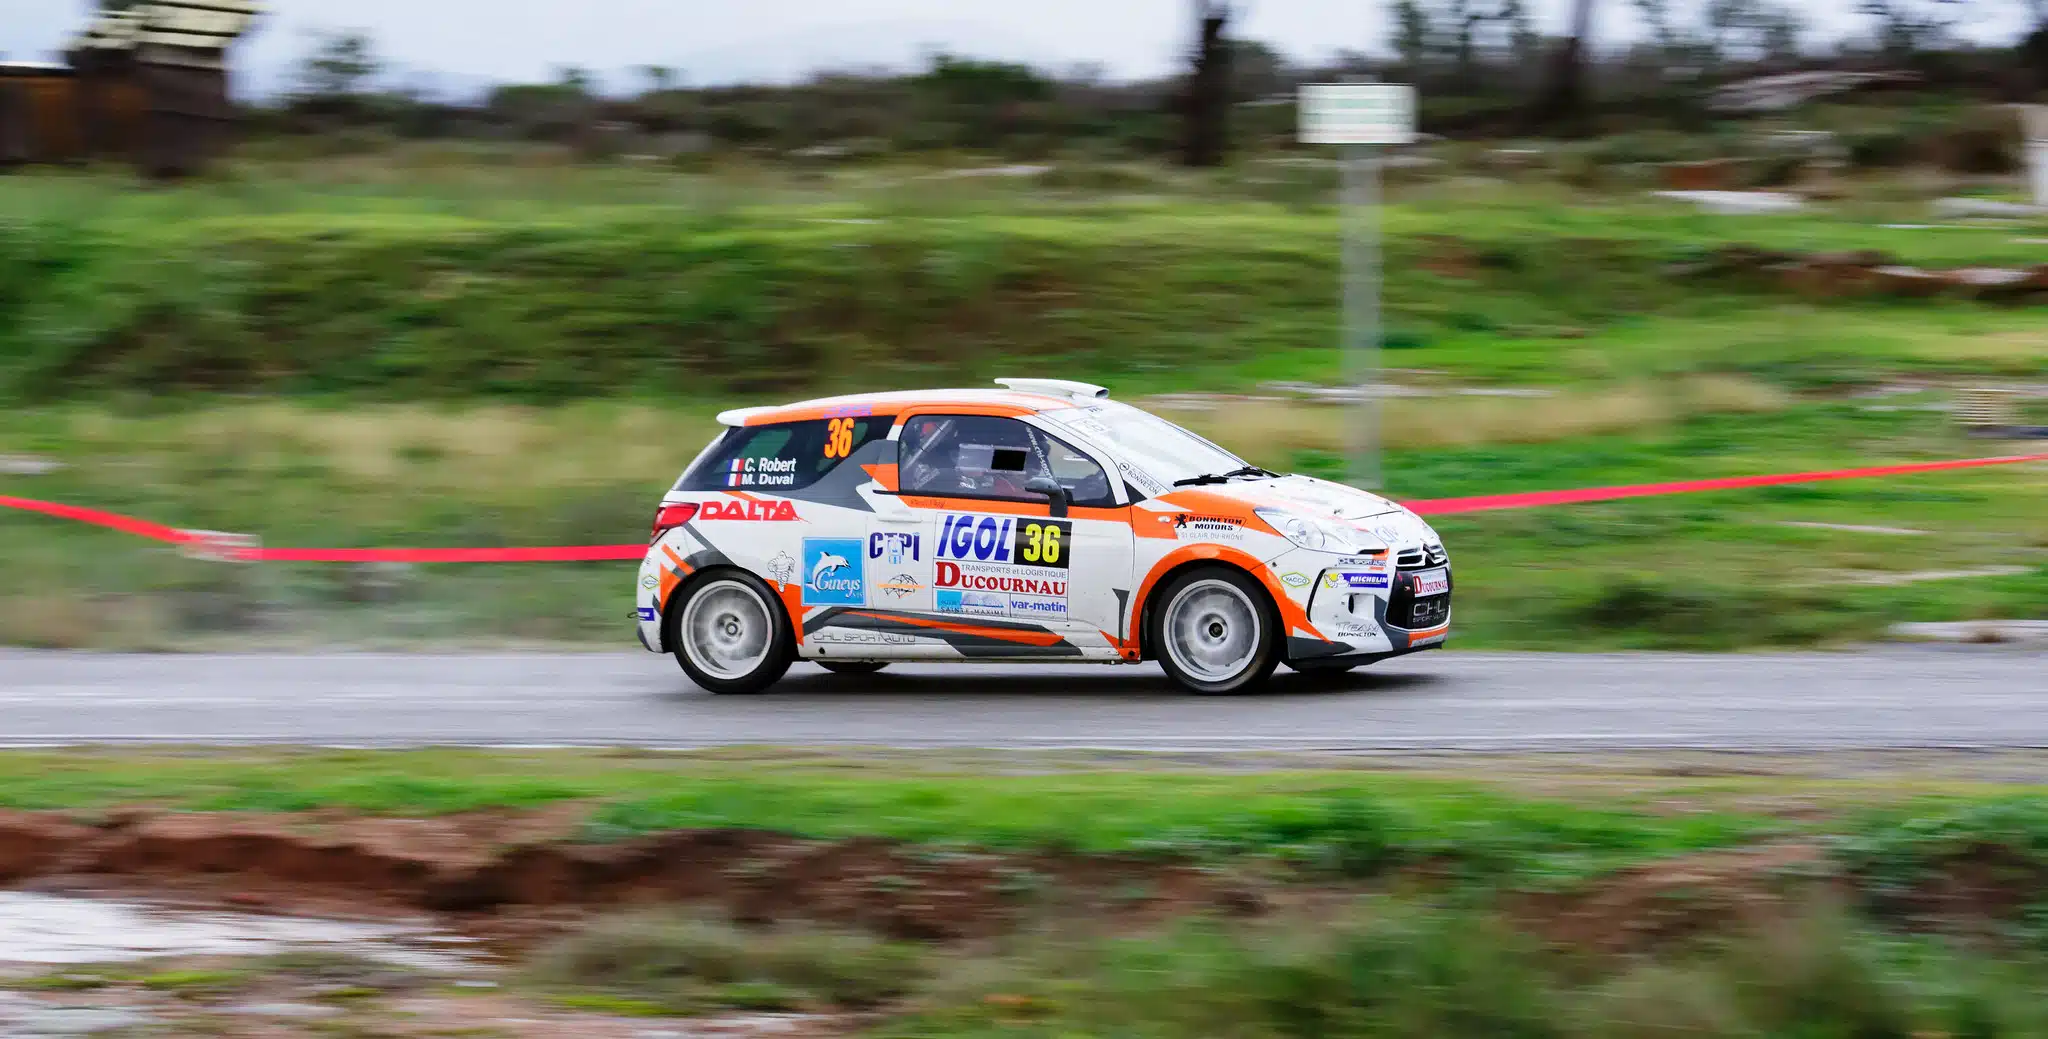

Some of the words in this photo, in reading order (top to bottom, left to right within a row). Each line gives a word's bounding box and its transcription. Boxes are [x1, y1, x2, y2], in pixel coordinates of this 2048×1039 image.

[824, 417, 855, 459] 36
[744, 458, 756, 473] C.
[758, 457, 797, 472] Robert
[741, 473, 755, 486] M.
[758, 473, 795, 485] Duval
[1127, 469, 1159, 495] BONNETON
[699, 500, 801, 521] DALTA
[1189, 515, 1243, 525] BONNETON
[1194, 523, 1234, 531] MOTORS
[936, 514, 1012, 562] IGOL
[1023, 522, 1061, 564] 36
[869, 531, 920, 562] CTPI
[935, 561, 1067, 596] DUCOURNAU
[961, 564, 1011, 575] TRANSPORTS
[1020, 569, 1067, 579] LOGISTIQUE
[1285, 575, 1307, 585] YACCO
[1350, 575, 1388, 584] MICHELIN
[940, 606, 1005, 616] SAINTE-MAXIME
[1011, 600, 1067, 613] var-matin
[1413, 601, 1446, 617] CHL
[813, 632, 842, 641] CHL
